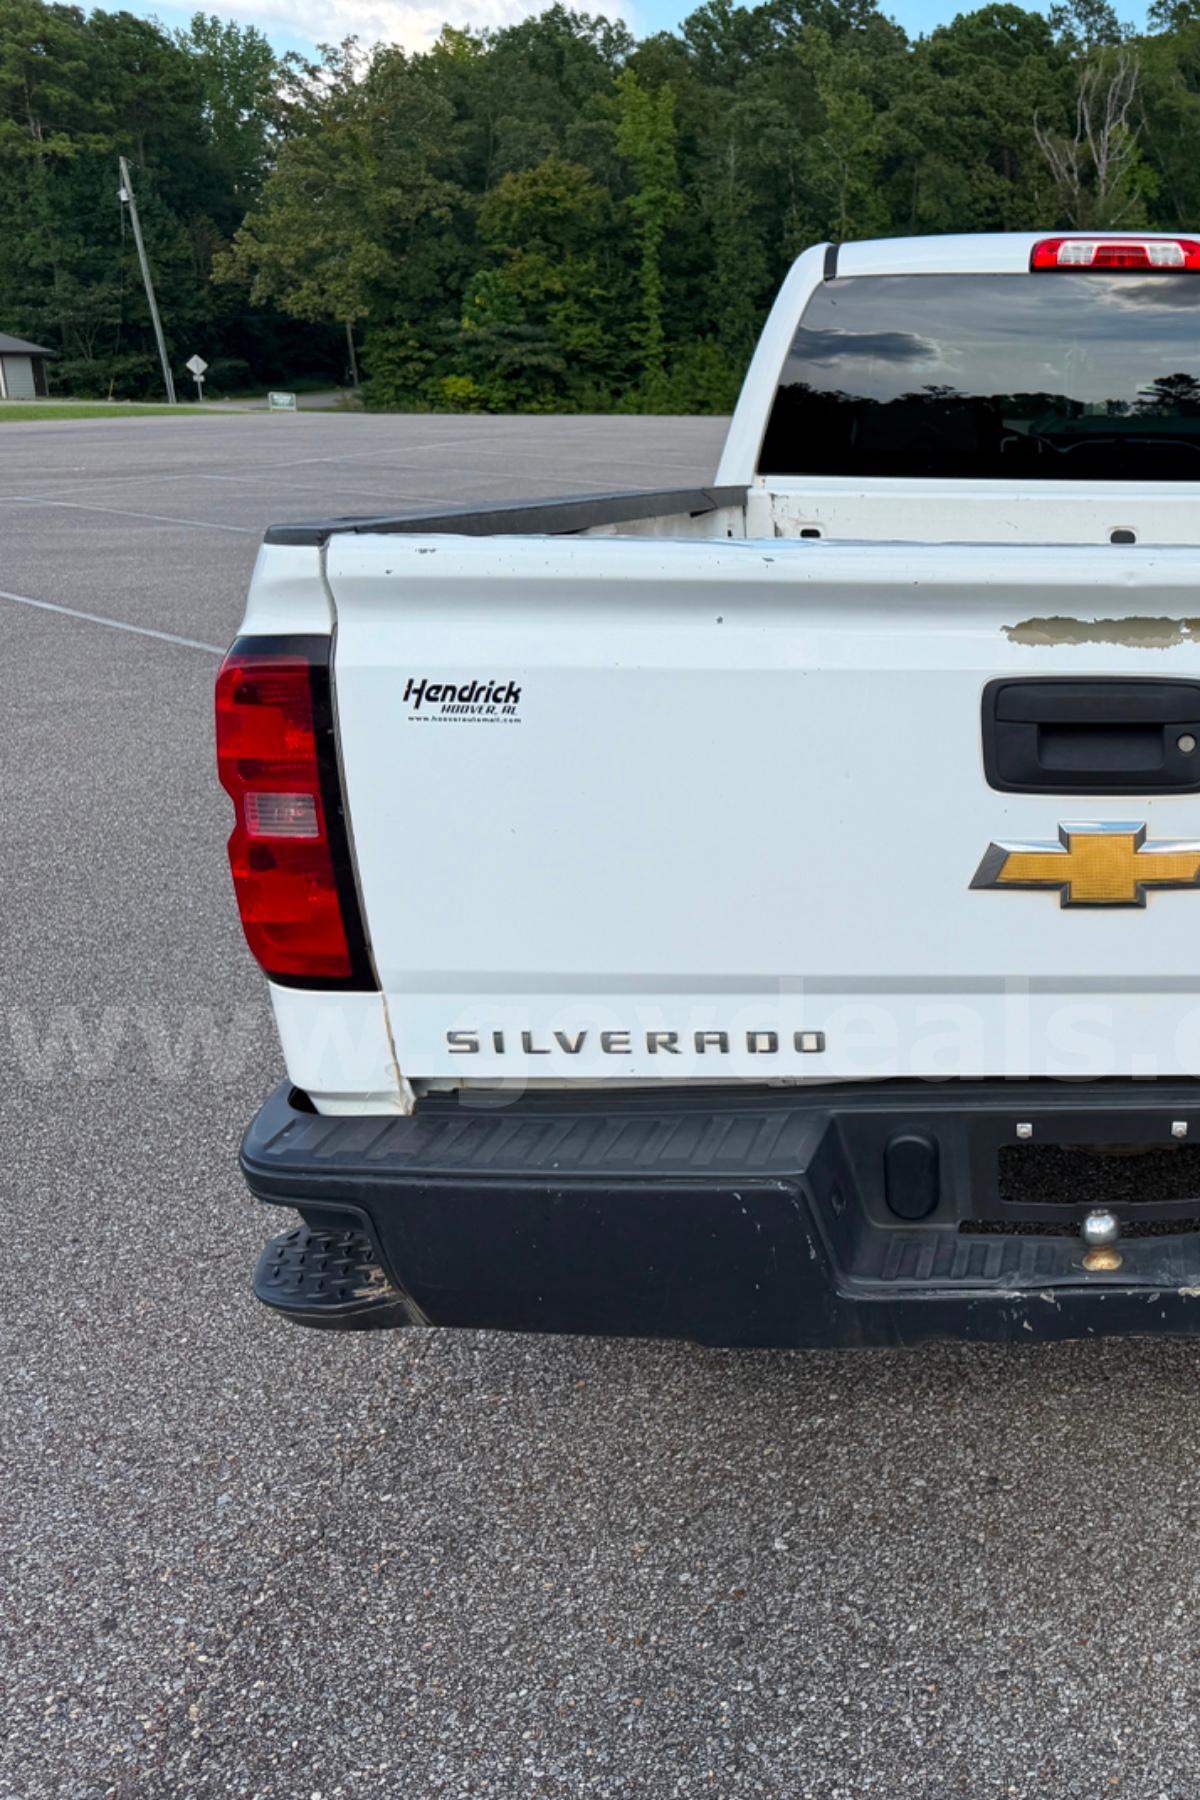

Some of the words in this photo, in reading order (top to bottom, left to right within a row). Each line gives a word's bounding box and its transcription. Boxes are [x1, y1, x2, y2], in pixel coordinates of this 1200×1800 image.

[403, 678, 522, 710] Hendrick
[501, 704, 518, 715] AL
[446, 1030, 827, 1055] SILVERADO
